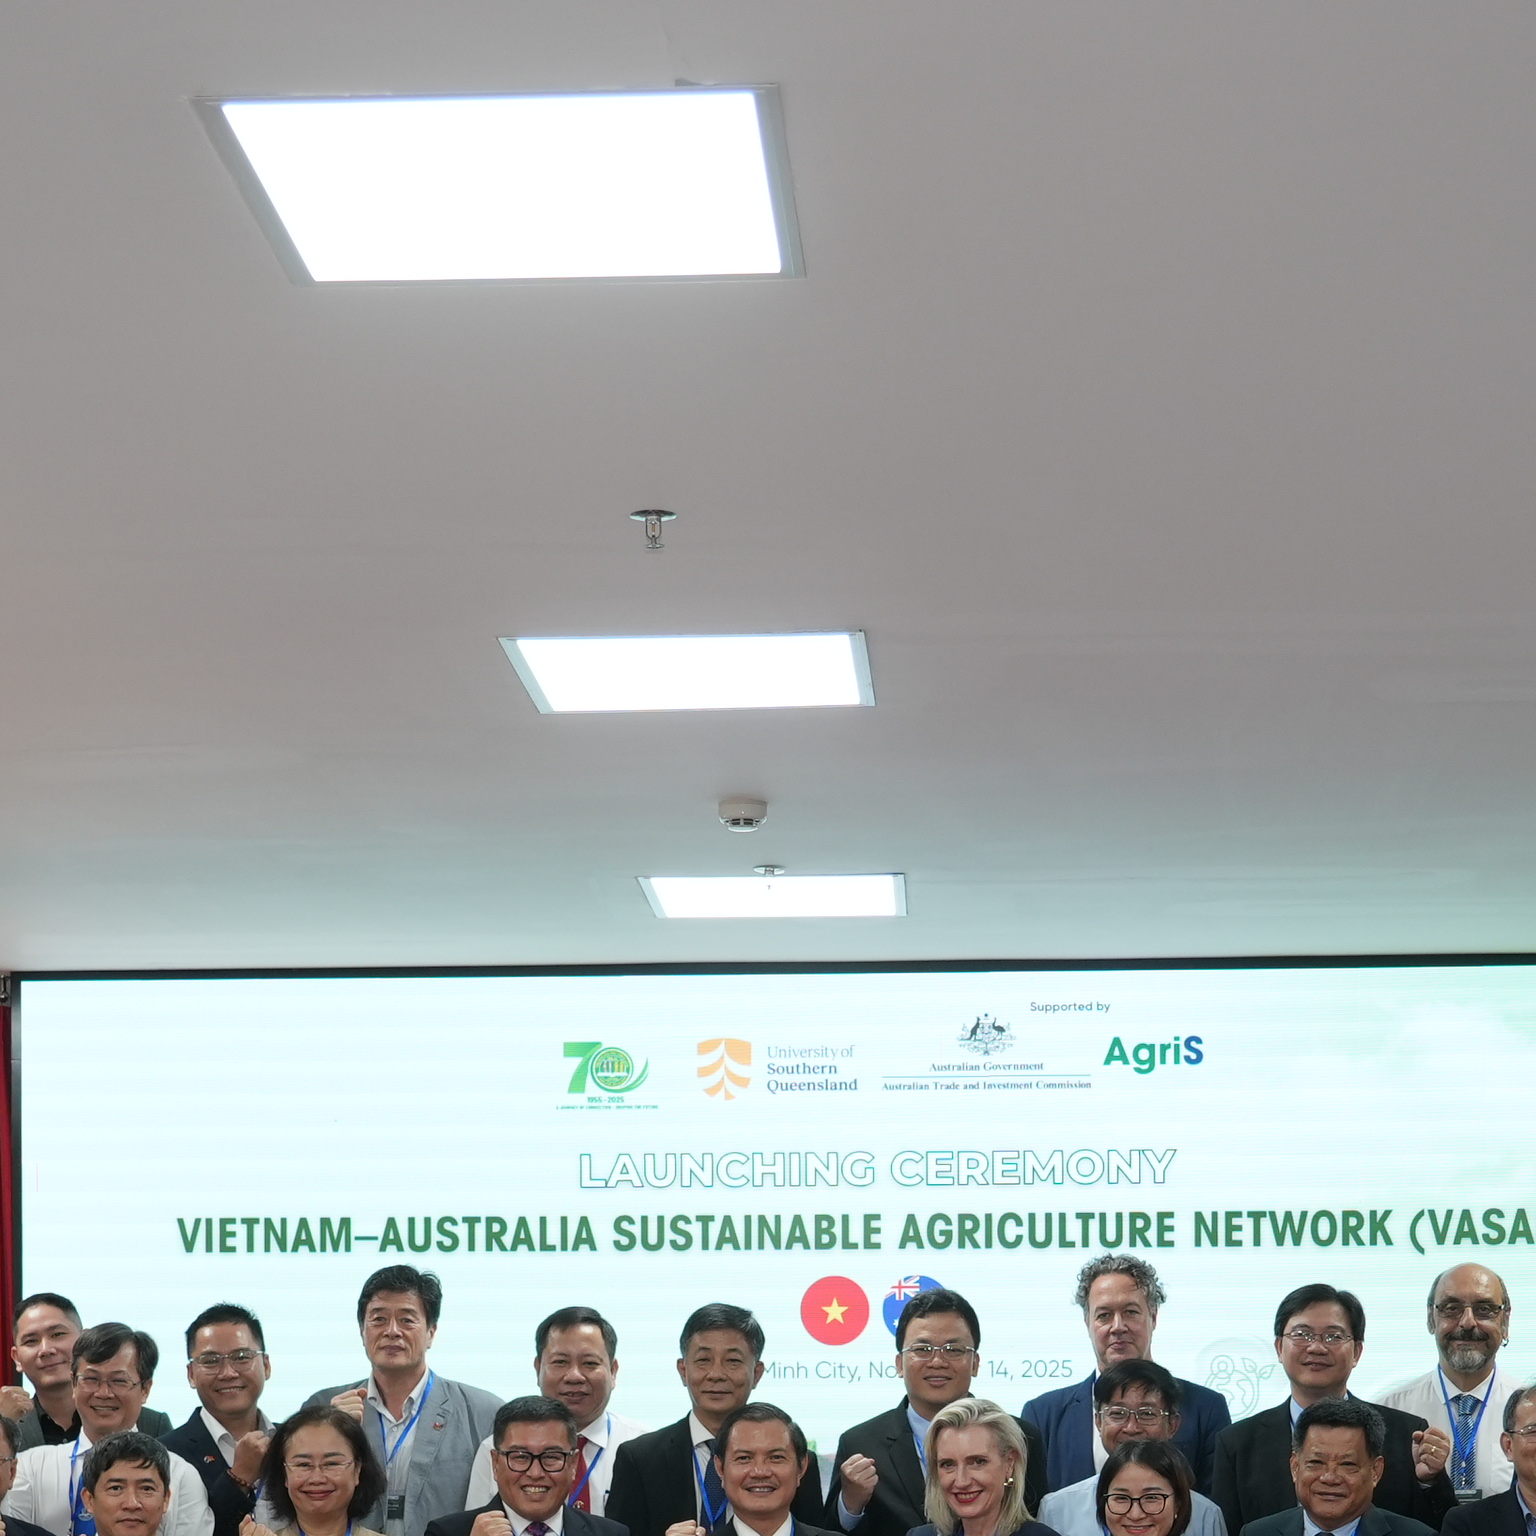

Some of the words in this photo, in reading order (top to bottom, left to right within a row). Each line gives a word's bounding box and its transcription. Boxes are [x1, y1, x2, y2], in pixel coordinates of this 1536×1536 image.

[1030, 1001, 1093, 1013] Supported
[1096, 1001, 1111, 1013] by
[767, 1045, 839, 1060] University
[840, 1044, 855, 1059] of
[1103, 1035, 1204, 1075] AgriS
[767, 1062, 837, 1075] Southern
[929, 1062, 981, 1072] Australian
[983, 1061, 1043, 1071] Government
[767, 1079, 858, 1094] Queensland
[882, 1082, 929, 1091] Australian
[933, 1082, 961, 1090] Trade
[963, 1081, 980, 1090] and
[983, 1081, 1033, 1090] Investment
[1036, 1081, 1092, 1090] Commission
[579, 1150, 875, 1188] LAUNCHING
[890, 1147, 1176, 1186] CEREMONY
[613, 1213, 883, 1251] SUSTAINABLE
[898, 1210, 1175, 1250] AGRICULTURE
[1194, 1208, 1392, 1249] NETWORK
[815, 1361, 861, 1383] City,
[988, 1360, 1013, 1381] 14,
[1021, 1360, 1073, 1378] 2025
